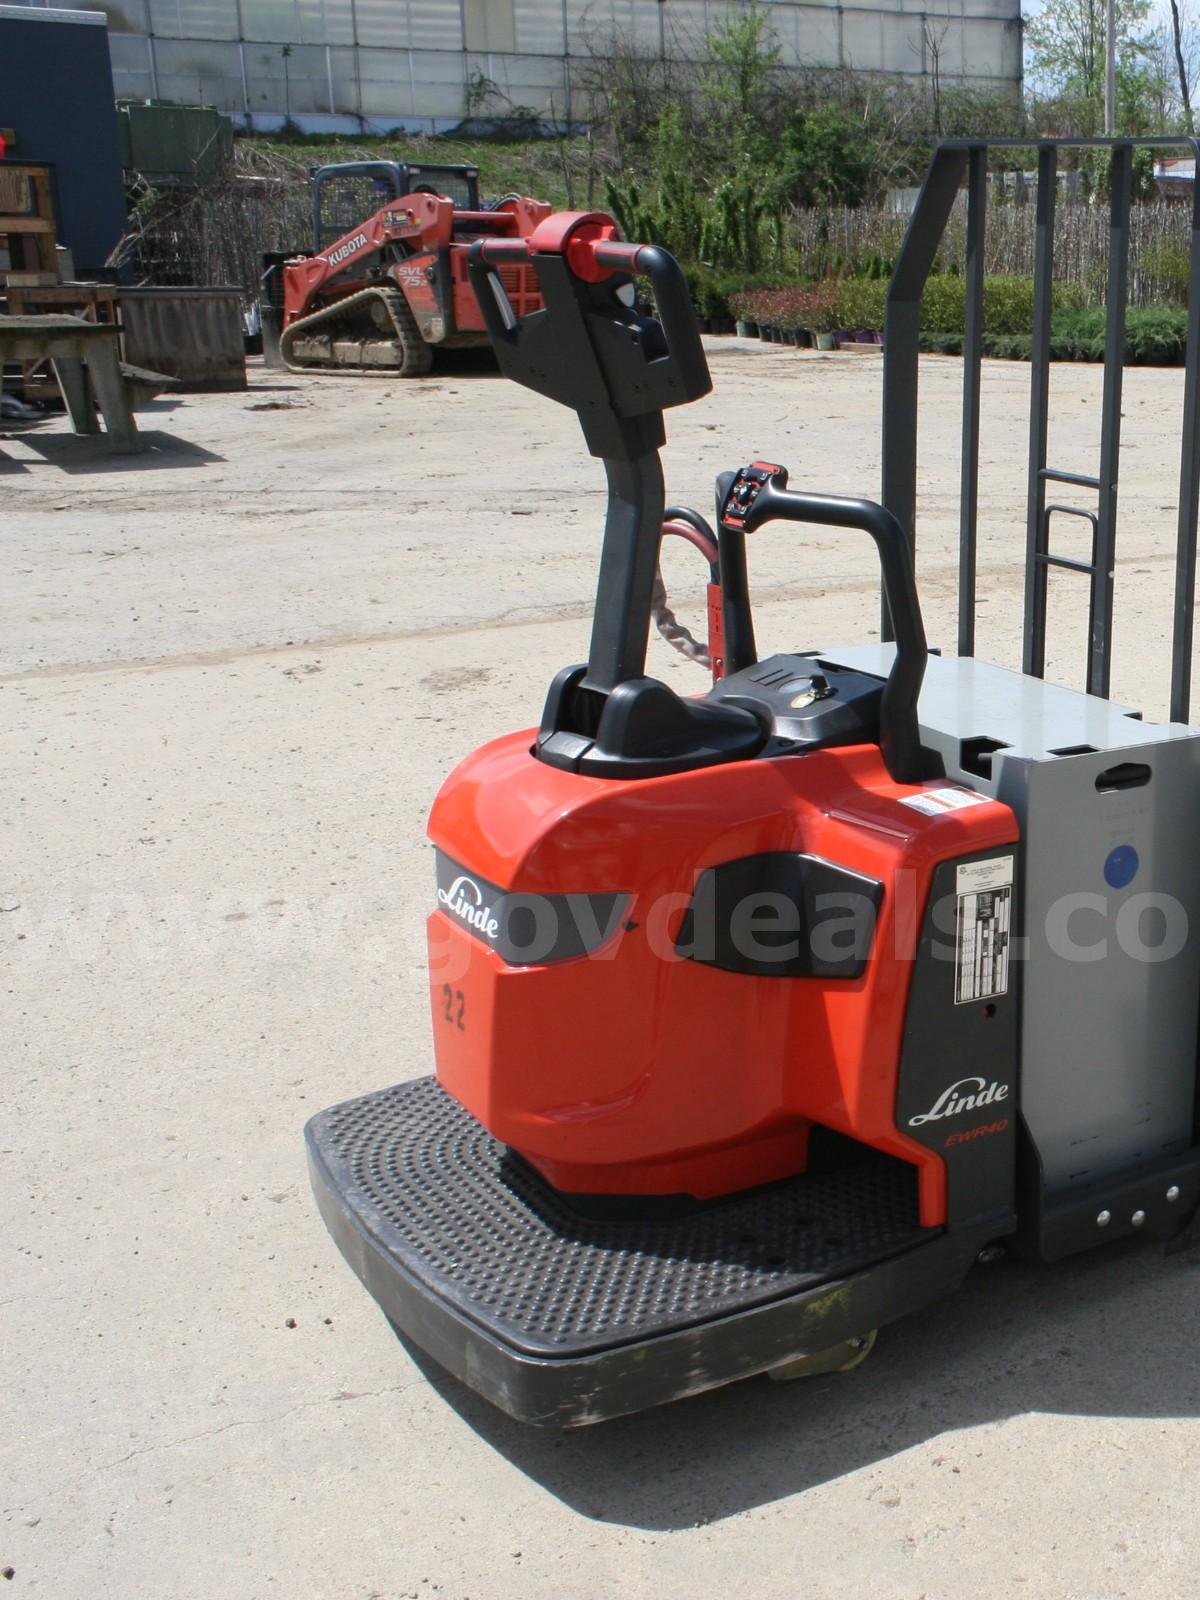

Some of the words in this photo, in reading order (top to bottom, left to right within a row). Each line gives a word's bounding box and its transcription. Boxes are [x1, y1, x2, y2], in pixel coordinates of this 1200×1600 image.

[327, 233, 368, 267] KUBOTA
[400, 266, 424, 276] SVL
[438, 876, 499, 938] Linde
[443, 982, 466, 1032] 22
[908, 1077, 1009, 1127] Linde
